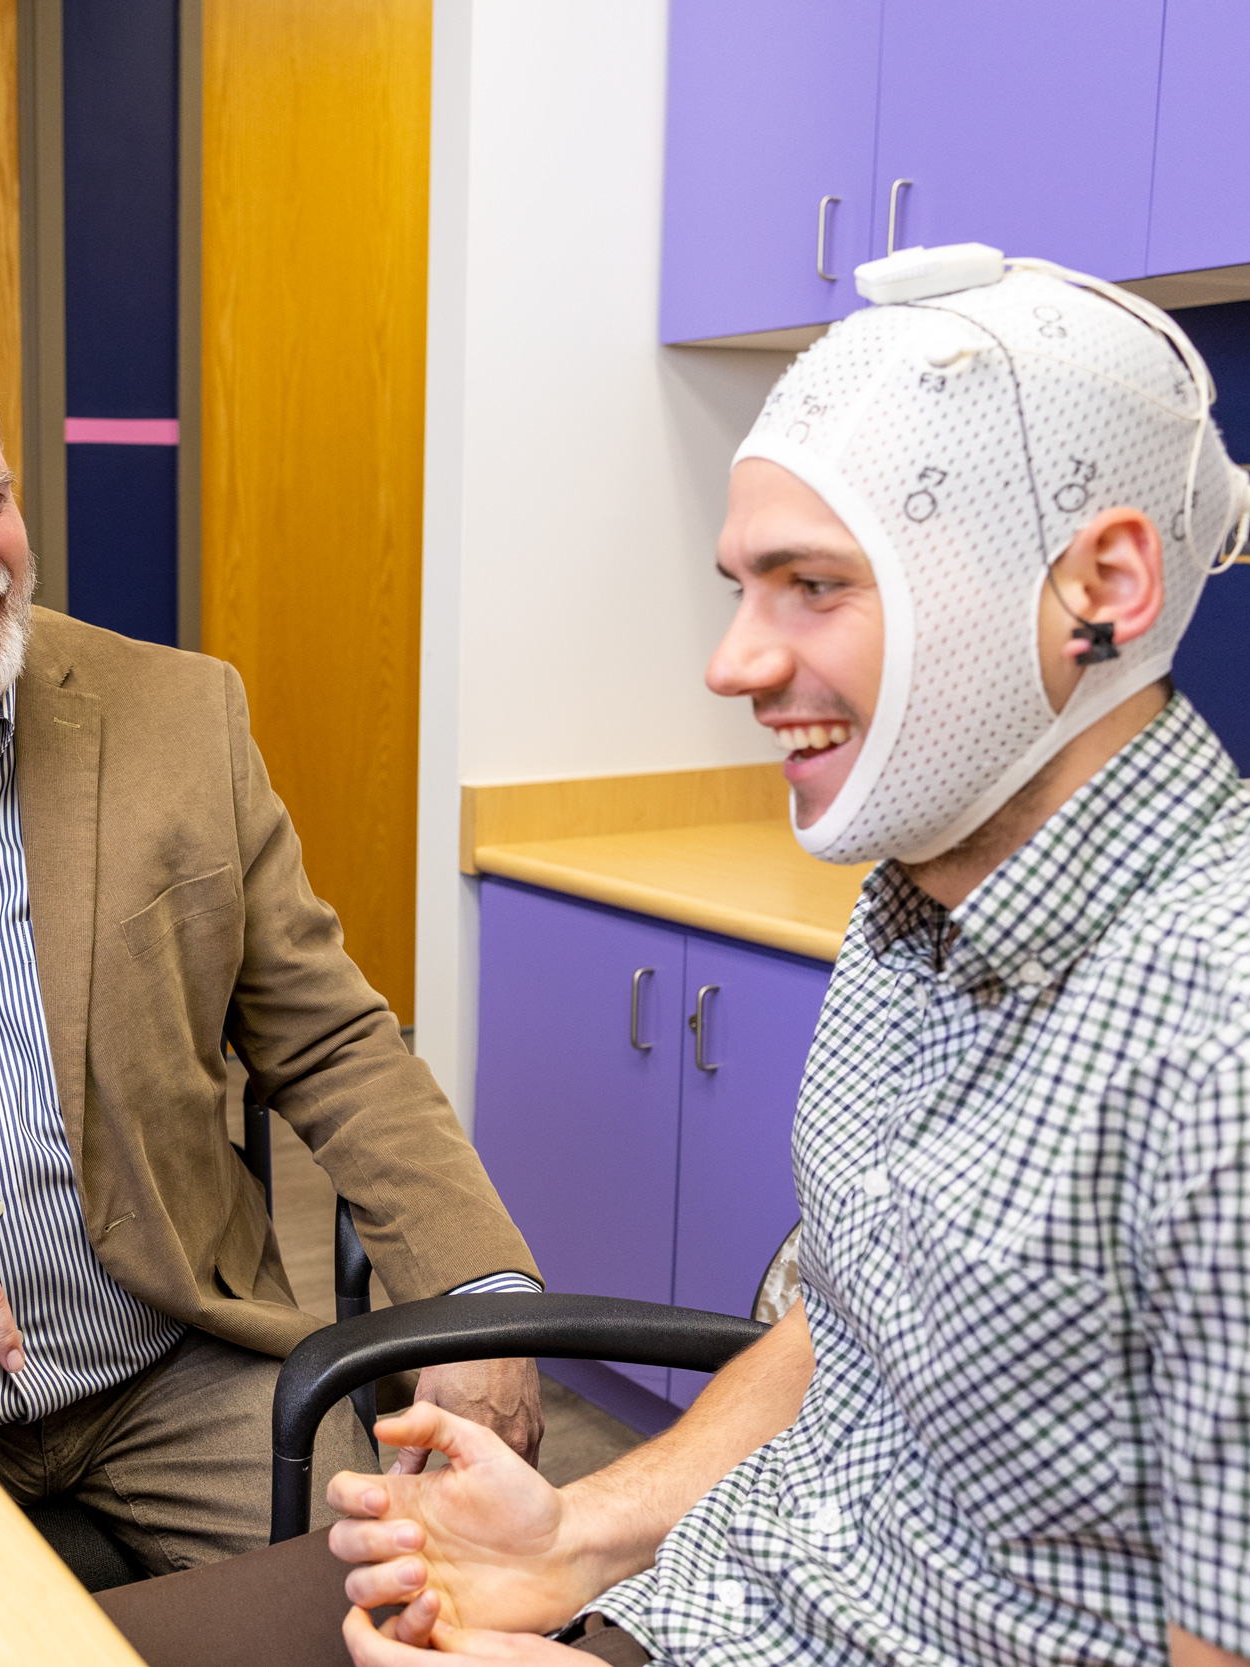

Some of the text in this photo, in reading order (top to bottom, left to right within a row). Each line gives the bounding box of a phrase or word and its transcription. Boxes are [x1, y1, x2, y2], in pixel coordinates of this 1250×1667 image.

[918, 372, 947, 393] F3
[918, 466, 948, 488] F7
[1069, 454, 1097, 483] T3
